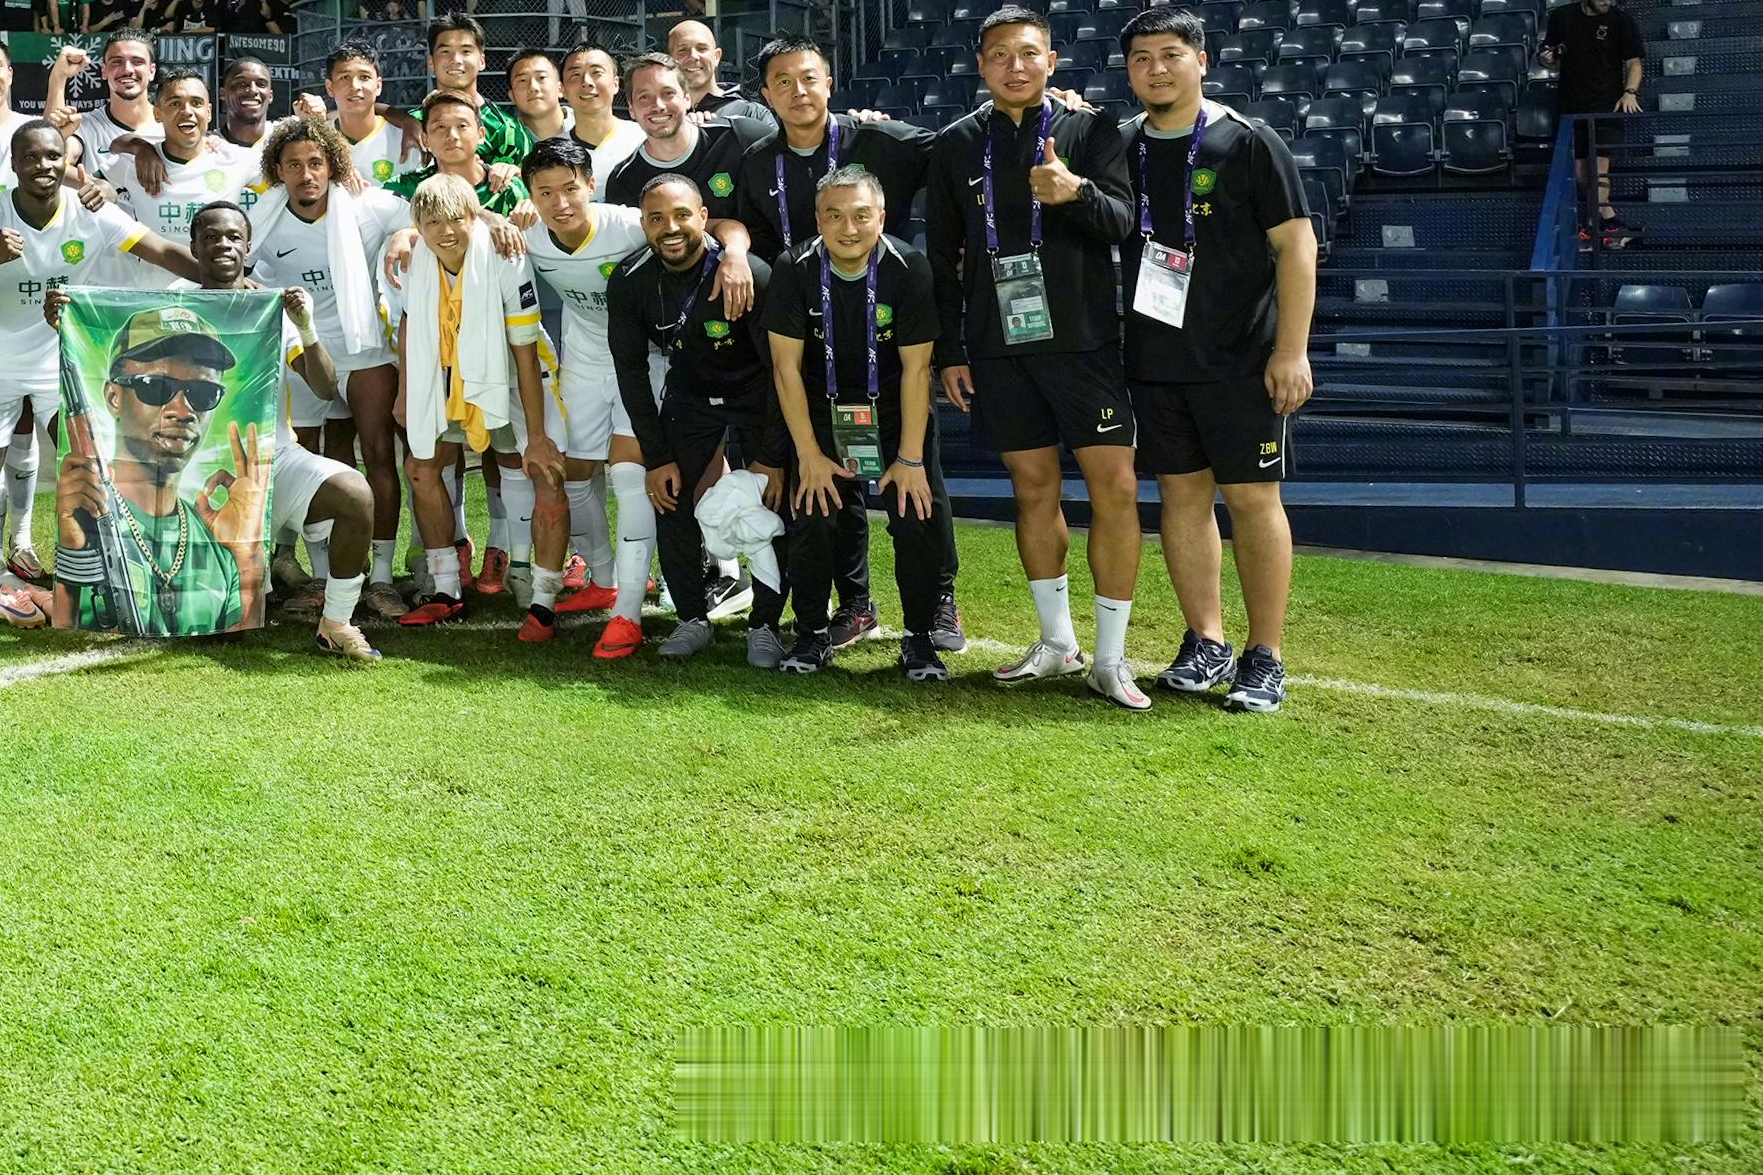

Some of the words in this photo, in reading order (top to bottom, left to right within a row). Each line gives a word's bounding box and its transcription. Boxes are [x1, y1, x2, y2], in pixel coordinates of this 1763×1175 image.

[229, 33, 286, 54] AWESOME90
[19, 100, 36, 109] YOU
[1101, 408, 1114, 421] LP
